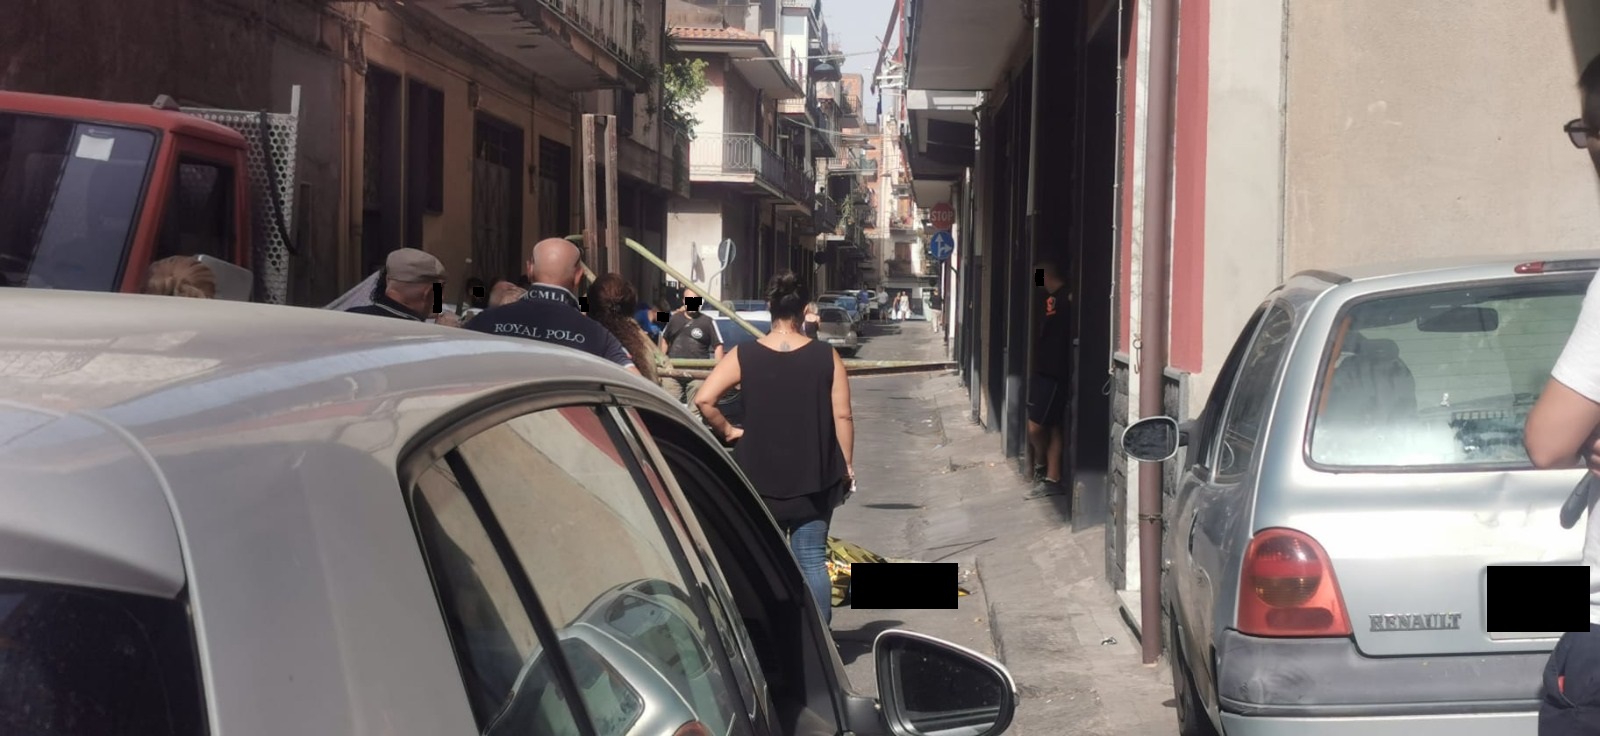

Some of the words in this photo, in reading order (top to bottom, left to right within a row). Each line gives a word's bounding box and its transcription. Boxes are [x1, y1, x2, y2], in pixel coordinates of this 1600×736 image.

[931, 210, 953, 221] STOP
[494, 323, 541, 338] ROYAL
[545, 329, 585, 344] POLO
[1369, 612, 1461, 632] RENAULT
